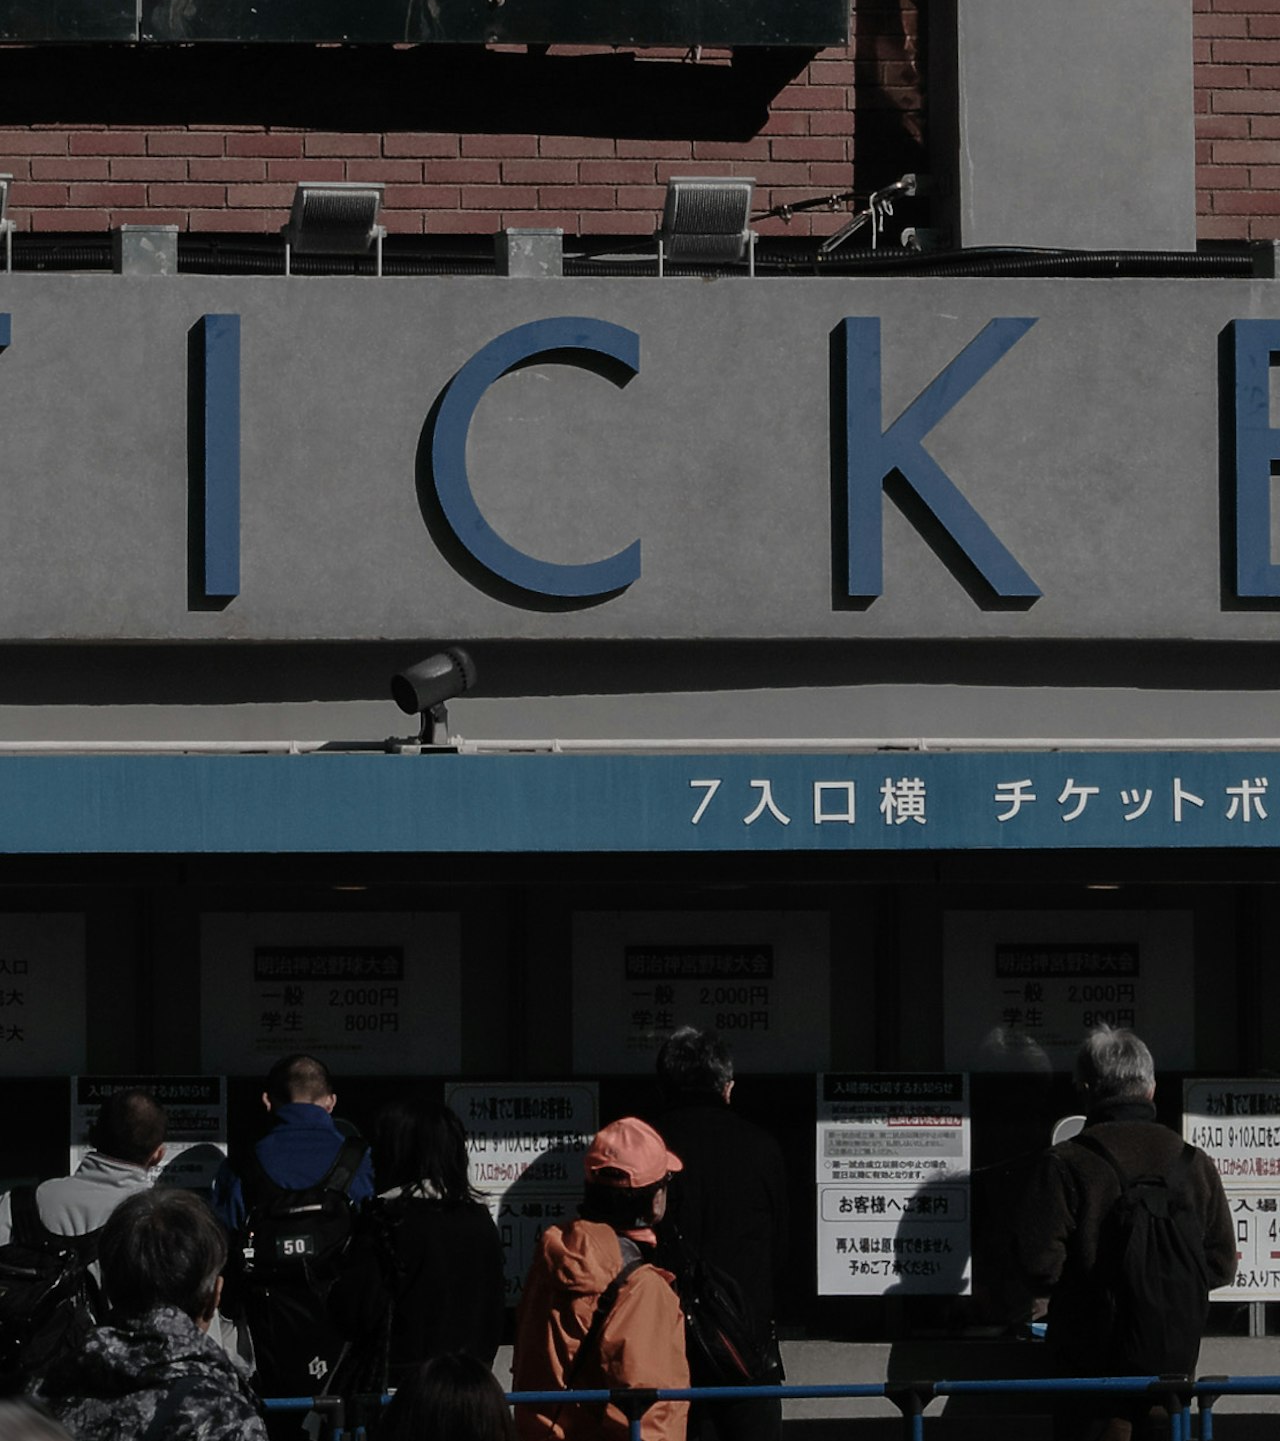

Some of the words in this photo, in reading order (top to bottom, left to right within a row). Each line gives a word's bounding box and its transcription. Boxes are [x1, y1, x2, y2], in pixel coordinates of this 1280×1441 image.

[688, 777, 929, 828] 7入口横
[256, 954, 400, 976] 明治神宮野球大会
[627, 953, 769, 975] 明治神宮野球大会
[998, 951, 1135, 973] 明治神宮野球大会
[260, 984, 305, 1007] 一般
[328, 987, 399, 1009] 2,000円
[631, 983, 675, 1005] 一般
[699, 985, 769, 1008] 2,000円
[1003, 981, 1044, 1003] 一般
[1067, 983, 1136, 1004] 2,000円
[260, 1010, 305, 1033] 学生
[344, 1012, 400, 1032] 800円
[631, 1010, 675, 1030] 学生
[715, 1010, 769, 1031] 800円
[1002, 1007, 1044, 1029] 学生
